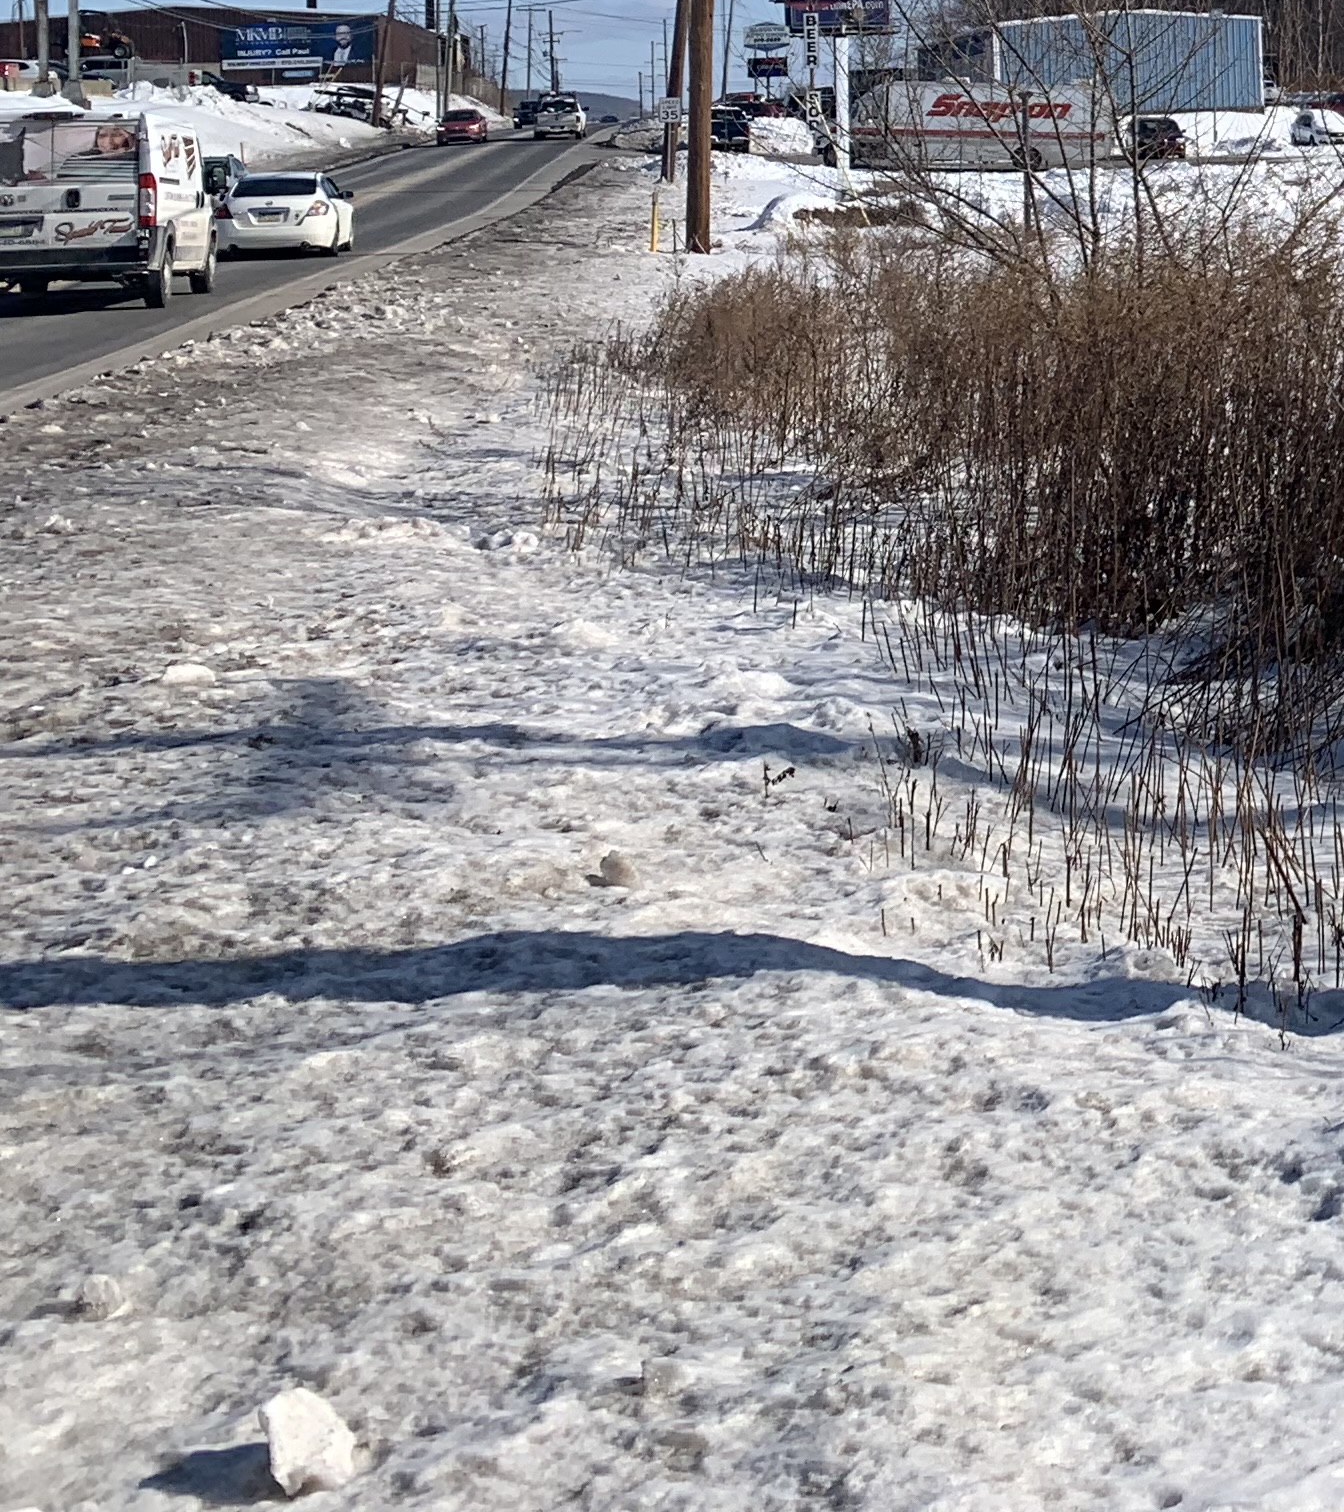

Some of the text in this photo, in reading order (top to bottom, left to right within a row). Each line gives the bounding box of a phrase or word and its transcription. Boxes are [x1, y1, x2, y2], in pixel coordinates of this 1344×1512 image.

[805, 15, 817, 66] BEER
[237, 47, 310, 57] INJURY? Call Paul
[662, 110, 678, 120] 35
